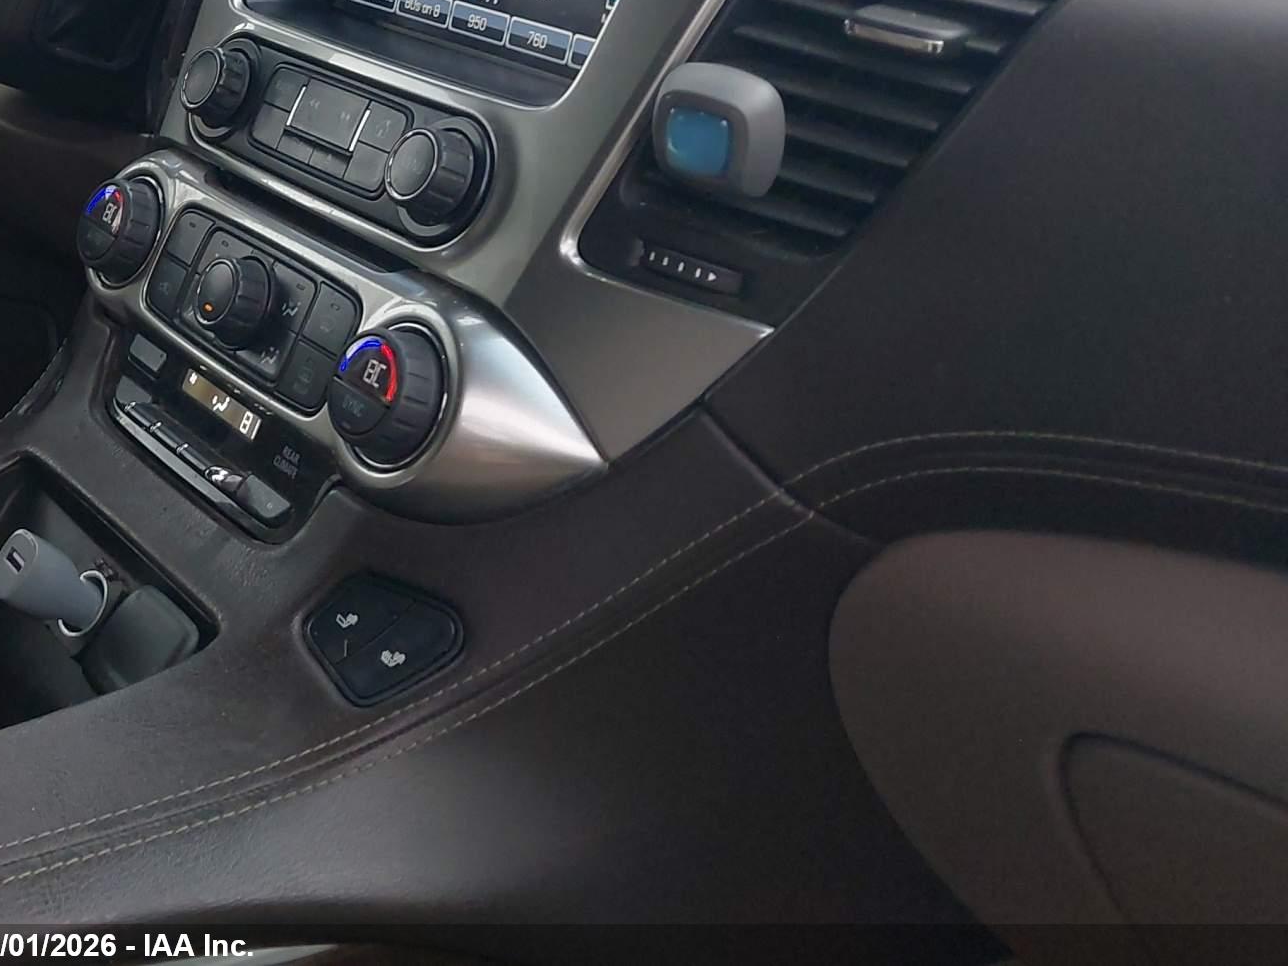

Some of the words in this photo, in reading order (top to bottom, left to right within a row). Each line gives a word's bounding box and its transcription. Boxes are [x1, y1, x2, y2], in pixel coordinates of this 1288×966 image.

[421, 2, 433, 15] on
[433, 4, 441, 18] 8
[467, 13, 488, 32] 950
[526, 30, 548, 50] 760
